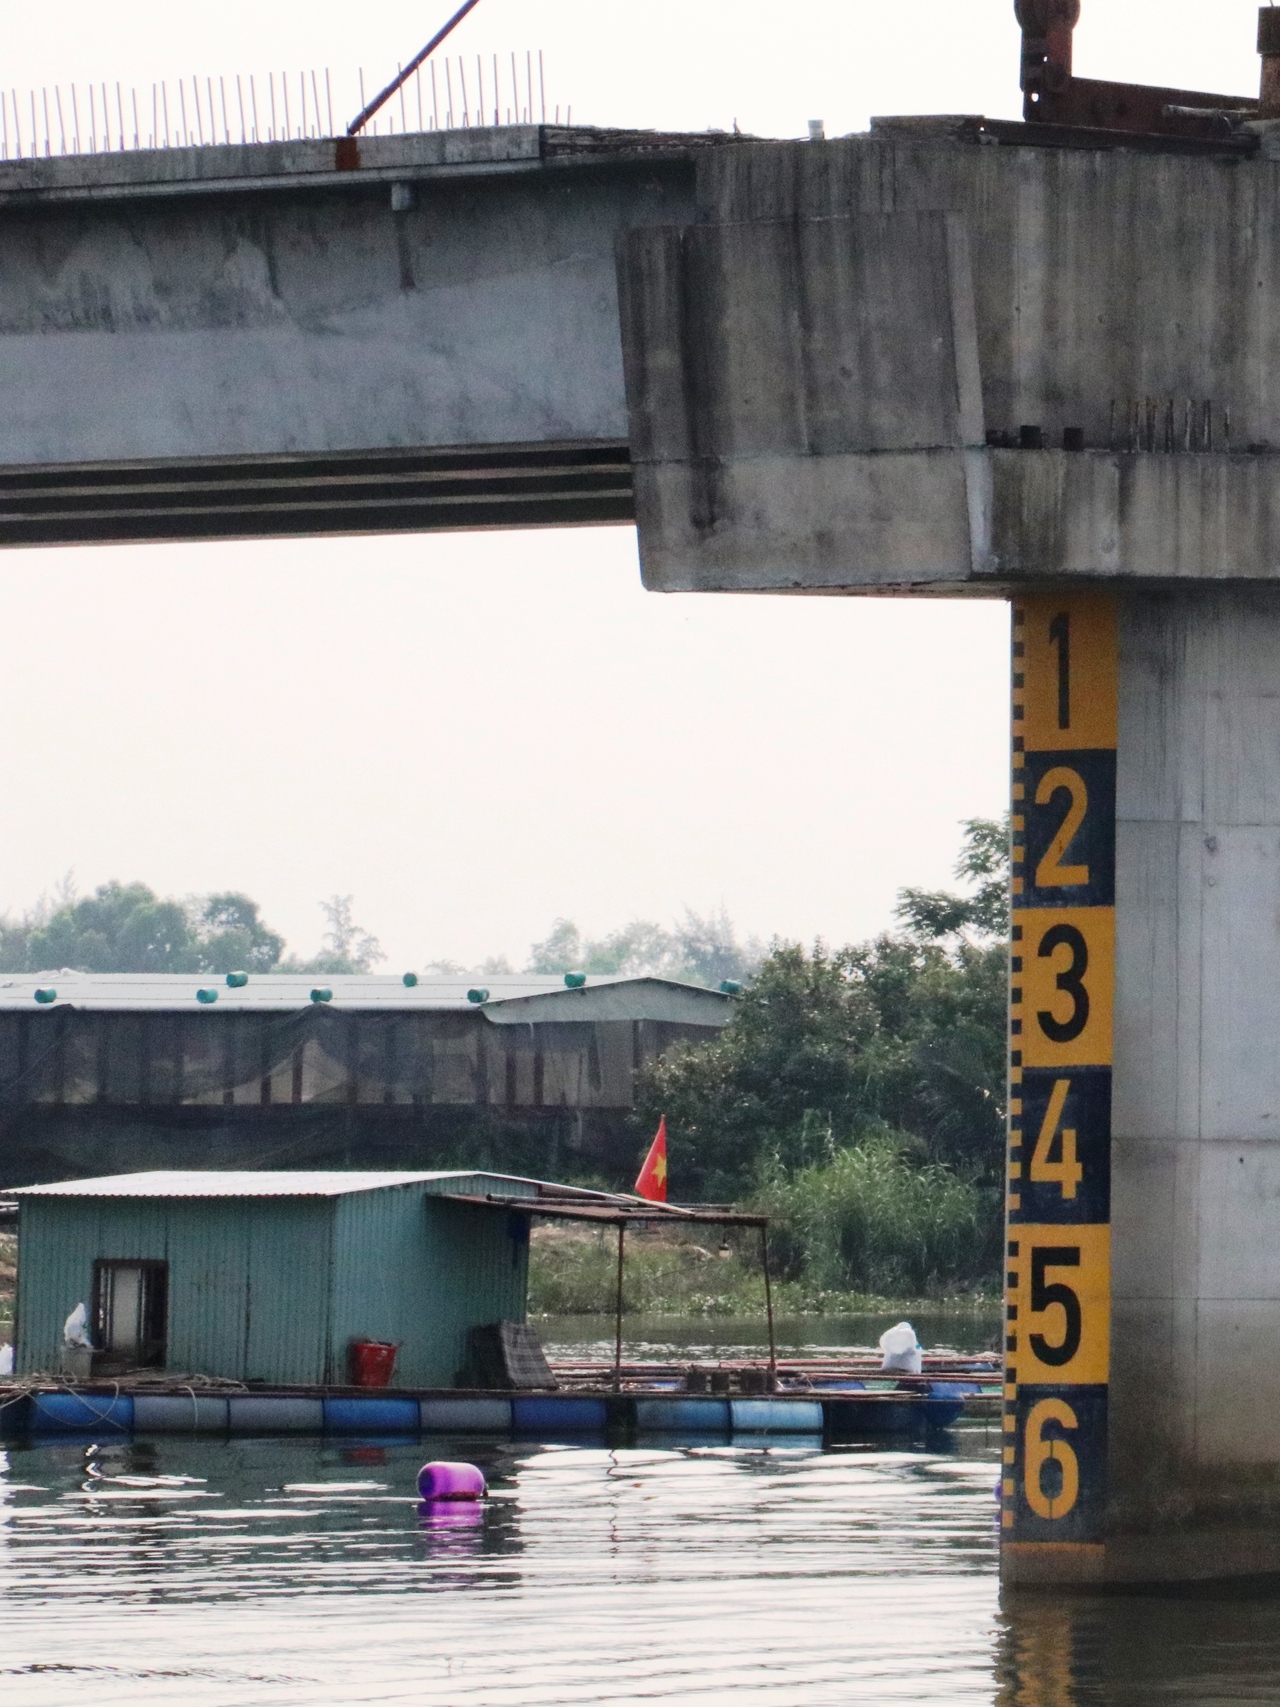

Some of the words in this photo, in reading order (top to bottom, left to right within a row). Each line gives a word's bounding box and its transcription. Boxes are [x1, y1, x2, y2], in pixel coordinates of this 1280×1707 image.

[1049, 612, 1070, 730] 1
[1035, 766, 1089, 887] 2
[1036, 923, 1089, 1042] 3
[1030, 1079, 1083, 1199] 4
[1029, 1246, 1081, 1366] 5
[1024, 1398, 1079, 1520] 6
